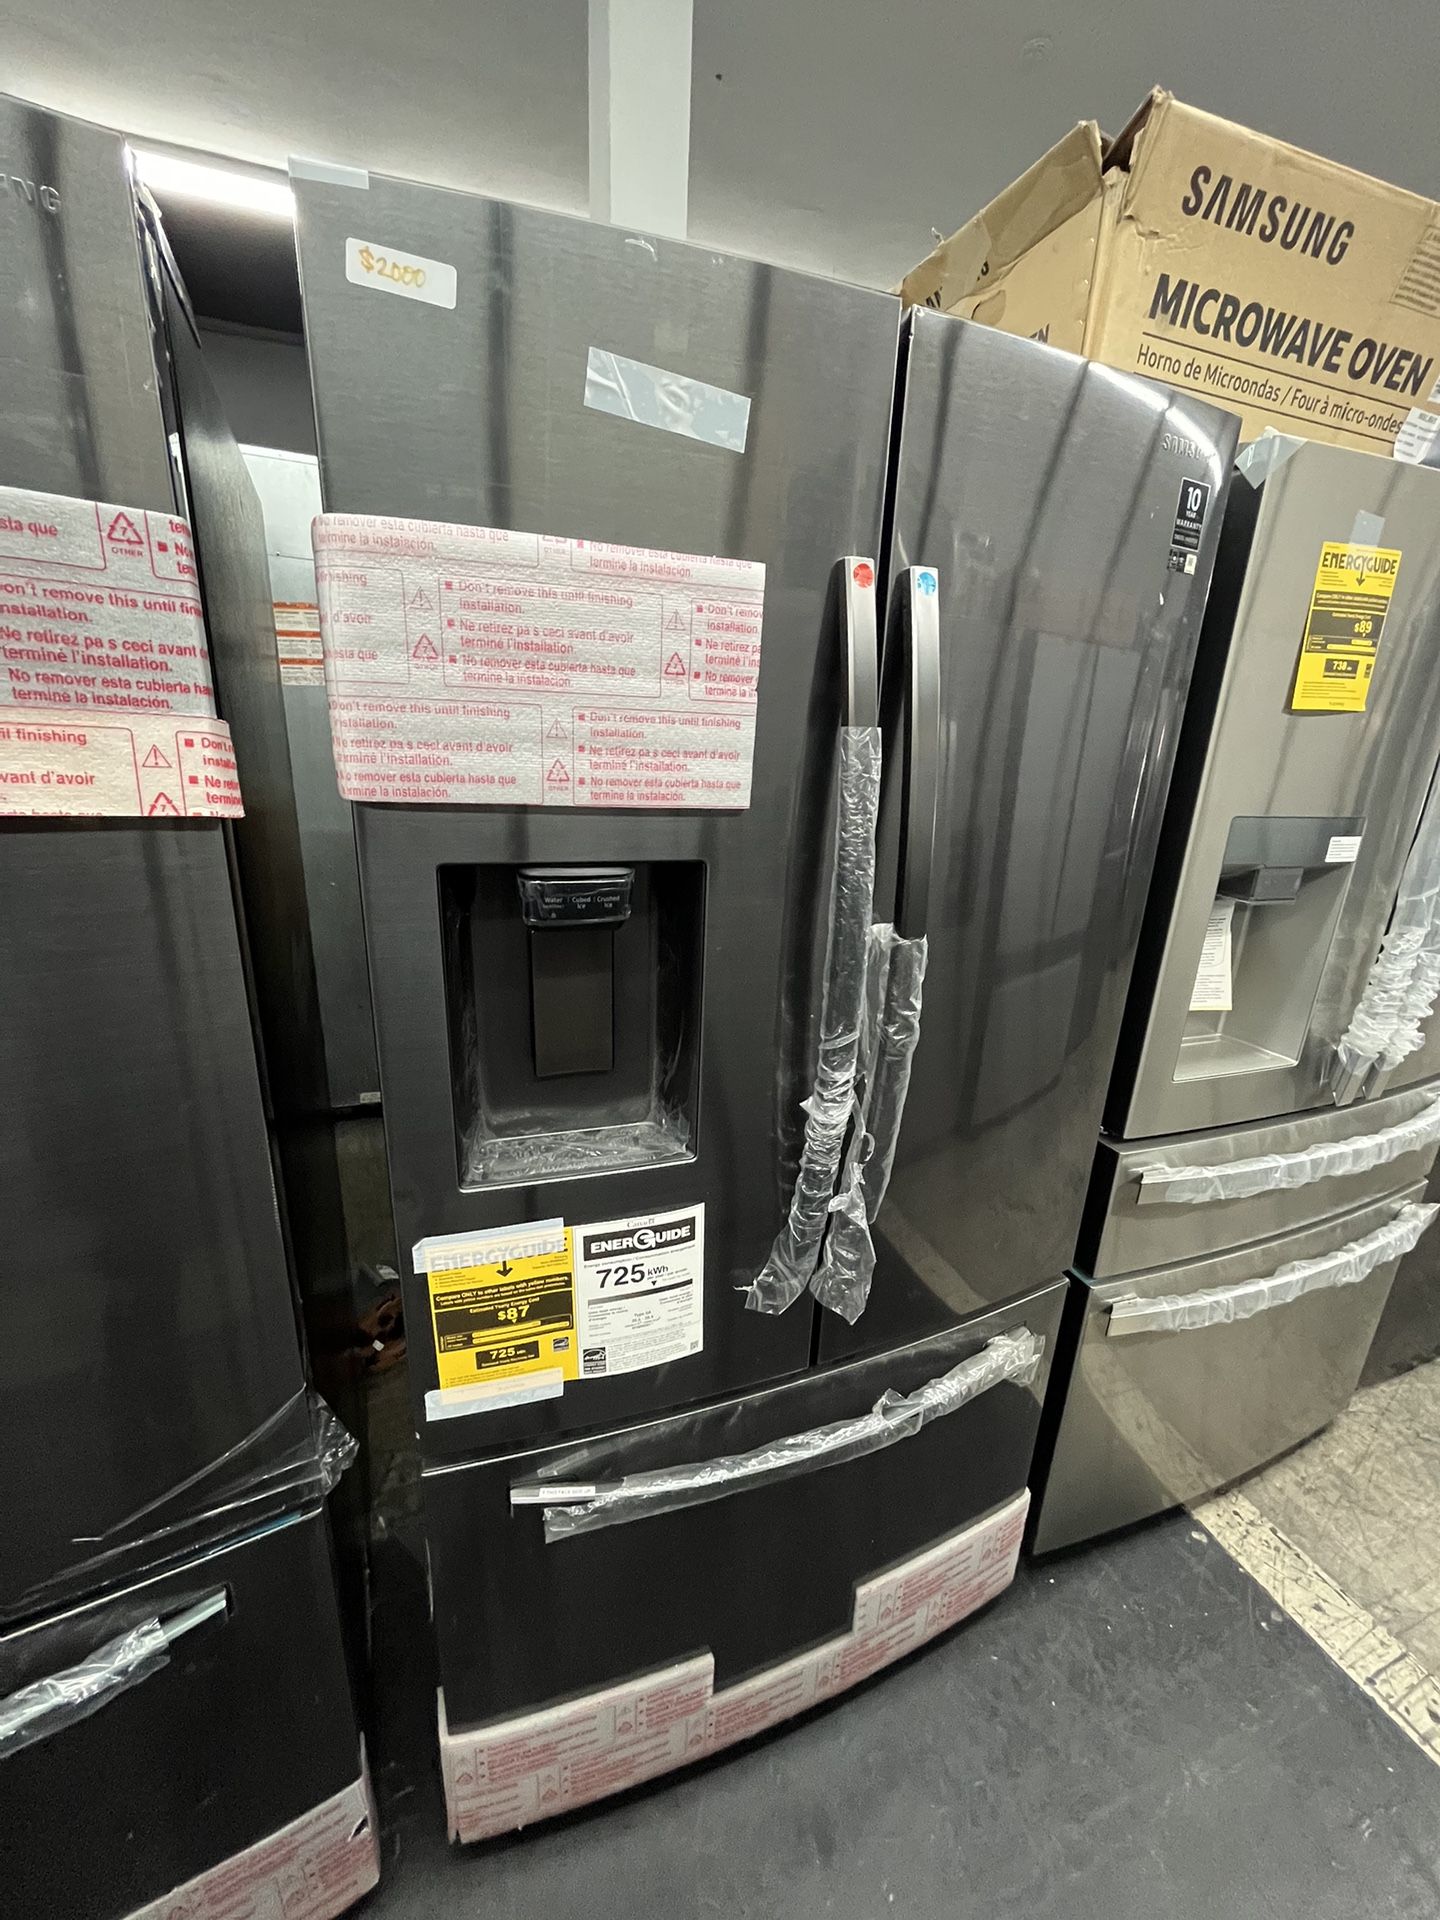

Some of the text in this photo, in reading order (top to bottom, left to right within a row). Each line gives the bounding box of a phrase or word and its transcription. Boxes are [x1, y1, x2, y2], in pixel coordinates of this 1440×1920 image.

[0, 173, 61, 214] NG
[1182, 165, 1356, 266] SAMSUNG
[359, 245, 426, 288] $2000
[1149, 273, 1434, 396] MICROWAVE OVEN
[1136, 343, 1181, 375] Horno
[1184, 357, 1201, 380] de
[1203, 363, 1281, 401] Microondas
[1291, 389, 1321, 414] Four
[1320, 395, 1329, 414] à
[1331, 401, 1403, 434] micro-ondes
[1186, 486, 1202, 512] 10
[1185, 510, 1197, 519] YEAR
[28, 521, 58, 538] que
[381, 519, 405, 531] esta
[408, 521, 453, 536] cubierta
[488, 530, 509, 544] que
[1176, 518, 1202, 531] WARRANTY
[111, 546, 143, 558] OTHER
[1322, 551, 1398, 575] ENERGYGUIDE
[0, 582, 176, 613] on't remove this until
[460, 620, 475, 632] Ne
[479, 621, 513, 635] retirez
[517, 626, 530, 638] pa
[1354, 620, 1373, 634] $89
[26, 629, 197, 657] retirez pa s ceci avant
[705, 638, 749, 653] Ne retirez
[2, 645, 173, 672] terminé l'installation.
[357, 651, 378, 663] que
[481, 657, 522, 669] remover
[525, 660, 546, 671] esta
[8, 668, 191, 694] No remover esta cubierta
[705, 671, 754, 684] No remover
[12, 686, 173, 709] termine la instalación.
[364, 703, 406, 713] remove
[410, 704, 431, 714] this
[435, 705, 459, 715] until
[463, 705, 510, 720] finishing
[658, 715, 676, 725] this
[702, 717, 741, 730] finishing
[16, 729, 87, 746] finishing
[351, 738, 386, 749] retirez
[417, 741, 440, 751] ceci
[442, 742, 472, 752] avant
[605, 746, 636, 757] retirez
[41, 771, 96, 785] d'avoir
[204, 776, 221, 788] Ne
[354, 771, 517, 787] remover esta cubierta hasta que
[590, 776, 604, 787] No
[605, 778, 643, 788] remover
[644, 778, 663, 788] esta
[665, 779, 699, 790] cubierta
[380, 786, 390, 798] la
[626, 790, 635, 801] la
[544, 894, 620, 904] Water Cubed Crushed
[576, 902, 613, 911] Ice Ice
[590, 1224, 691, 1254] ENERGUIDE
[596, 1263, 646, 1289] 725
[647, 1265, 669, 1276] kWh
[436, 1293, 461, 1303] Compare
[461, 1290, 477, 1299] ONLY
[484, 1287, 499, 1295] other
[499, 1284, 515, 1292] labels
[515, 1281, 527, 1289] with
[528, 1279, 545, 1288] yellow
[510, 1299, 528, 1308] Energy
[528, 1296, 540, 1304] Cost
[497, 1305, 530, 1321] $87
[489, 1347, 516, 1360] 725
